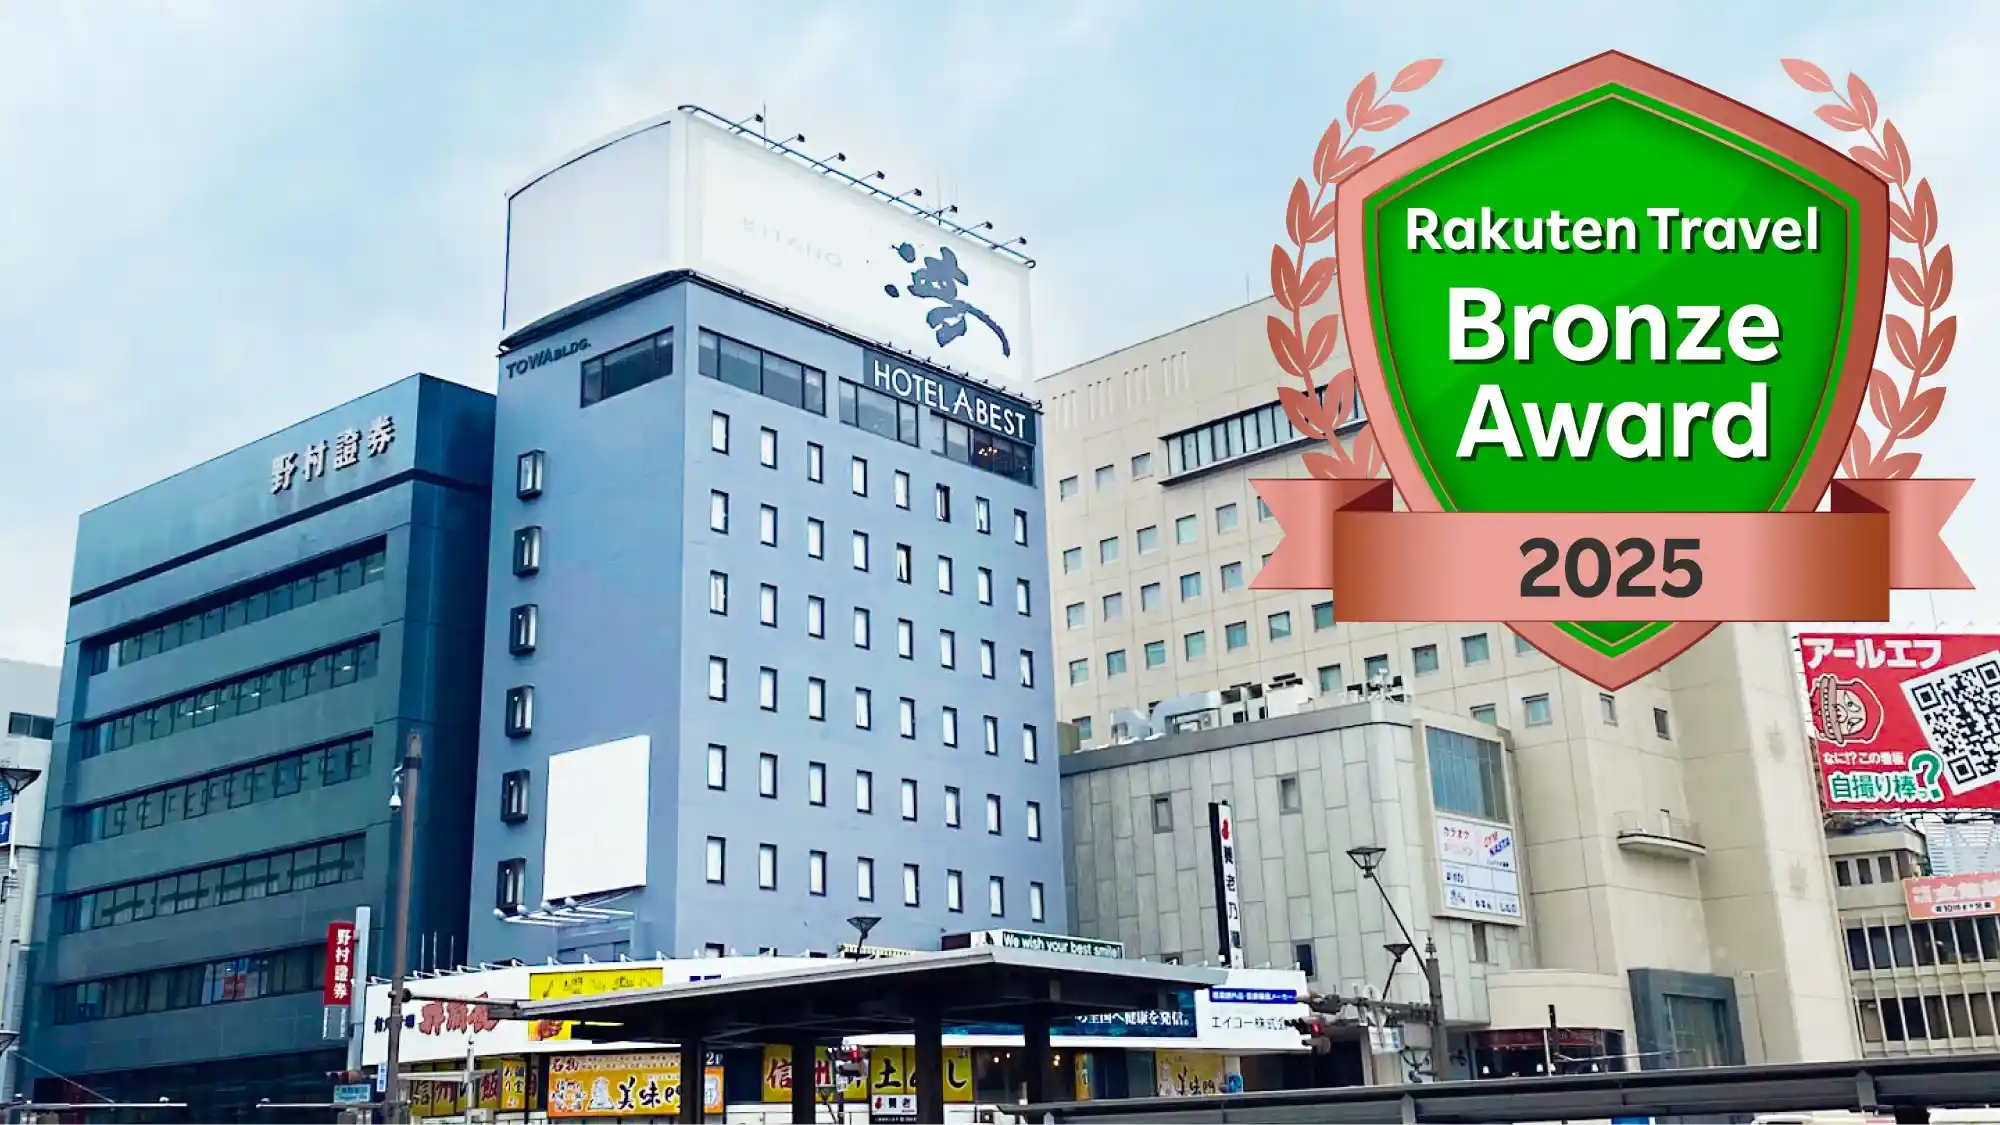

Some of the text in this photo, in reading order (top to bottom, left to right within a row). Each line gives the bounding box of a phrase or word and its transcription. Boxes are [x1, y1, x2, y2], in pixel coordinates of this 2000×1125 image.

[506, 348, 552, 379] TOWA
[873, 360, 1027, 440] HOTEL ABEST
[271, 415, 396, 494] 野村證券
[1801, 637, 1943, 670] アールエフ
[1003, 932, 1019, 948] We
[1021, 936, 1045, 950] wish
[1045, 939, 1069, 954] your
[1071, 941, 1092, 956] best
